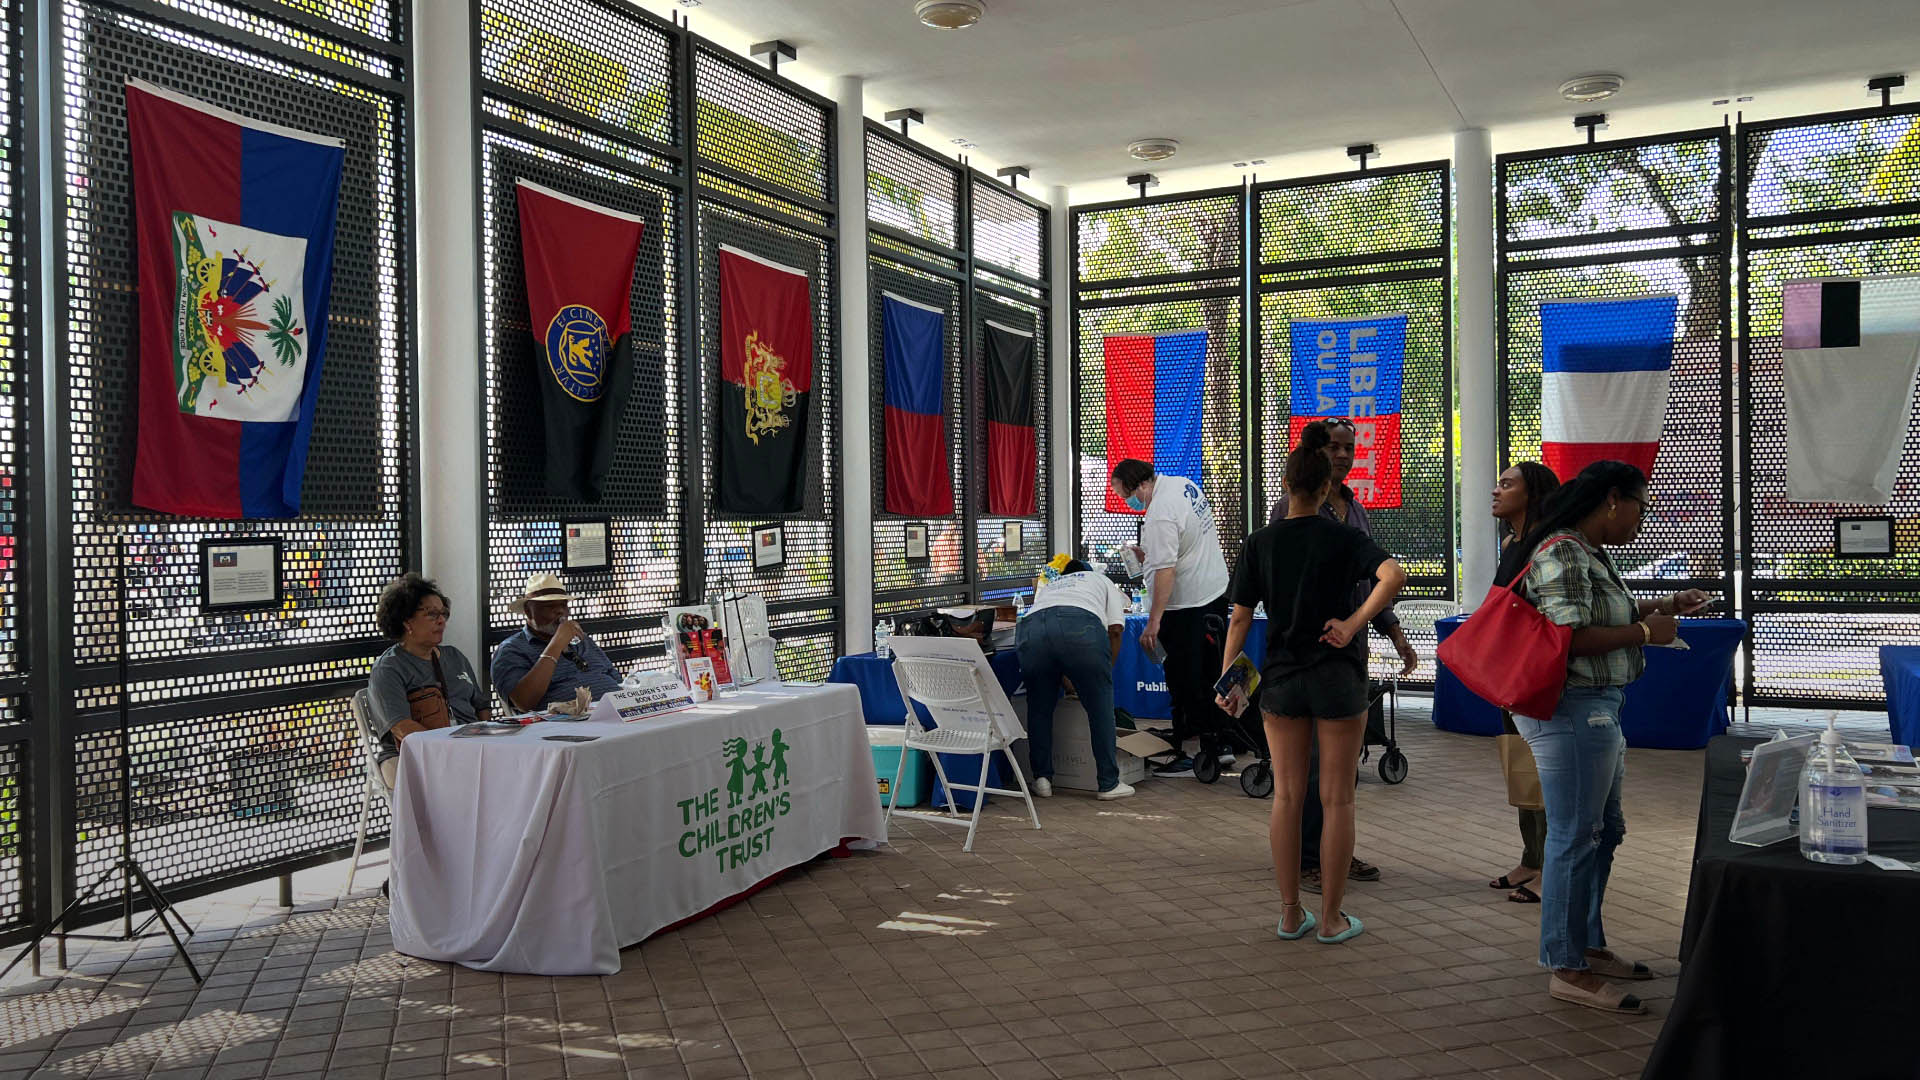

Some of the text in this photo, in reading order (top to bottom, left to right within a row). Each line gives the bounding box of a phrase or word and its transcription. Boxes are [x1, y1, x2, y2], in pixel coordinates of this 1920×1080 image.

[179, 317, 185, 326] LA
[1316, 329, 1338, 414] OU LA
[614, 683, 679, 700] THE CHILDREN'S TRUST
[1136, 681, 1169, 692] Publi
[677, 788, 719, 826] THE
[1823, 807, 1850, 818] Hand
[679, 791, 791, 858] CHILDREN'S
[1818, 816, 1856, 828] Sanitizer
[715, 826, 775, 873] TRUST
